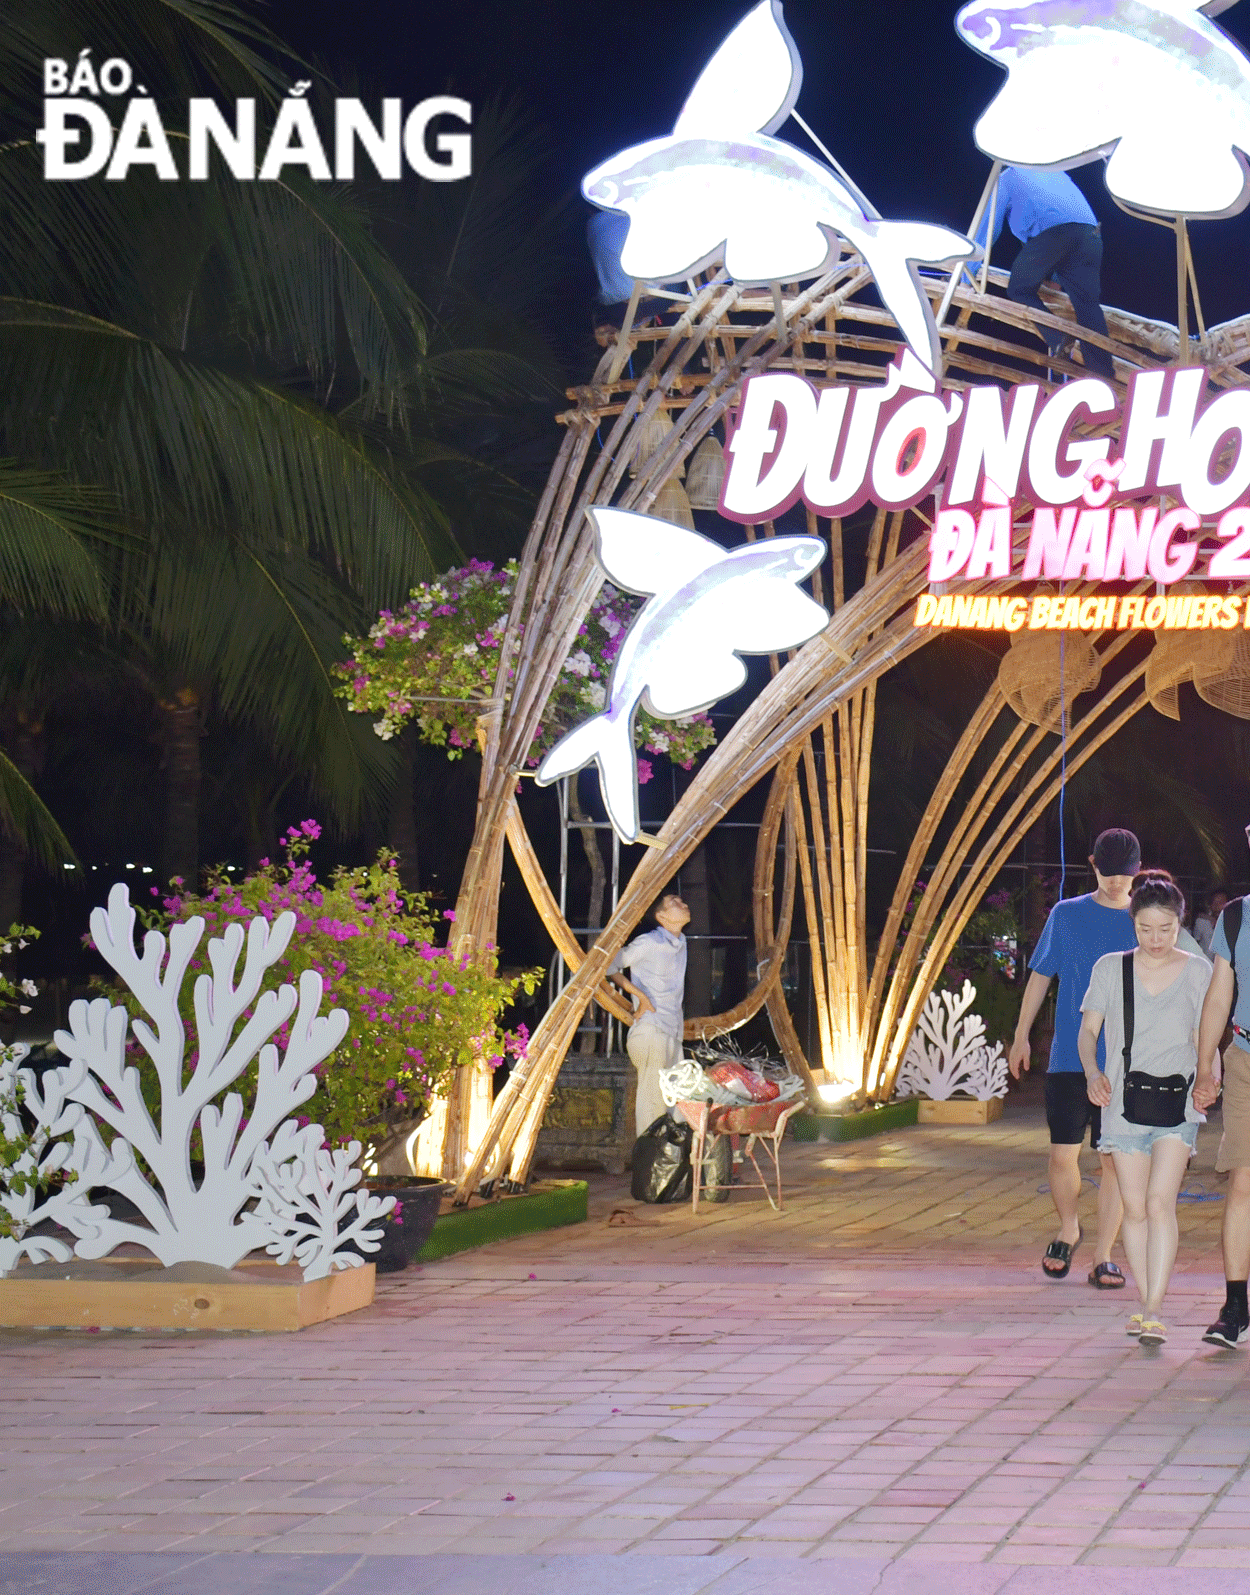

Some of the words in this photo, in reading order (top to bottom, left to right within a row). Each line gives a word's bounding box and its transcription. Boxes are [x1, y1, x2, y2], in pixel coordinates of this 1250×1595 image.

[720, 347, 1118, 516] ĐƯỜNG
[928, 475, 1012, 583] ĐÀ
[1021, 458, 1202, 585] NẴNG
[914, 593, 1029, 632] DANANG
[1028, 595, 1118, 631] BEACH
[1117, 594, 1243, 631] FLOWERS
